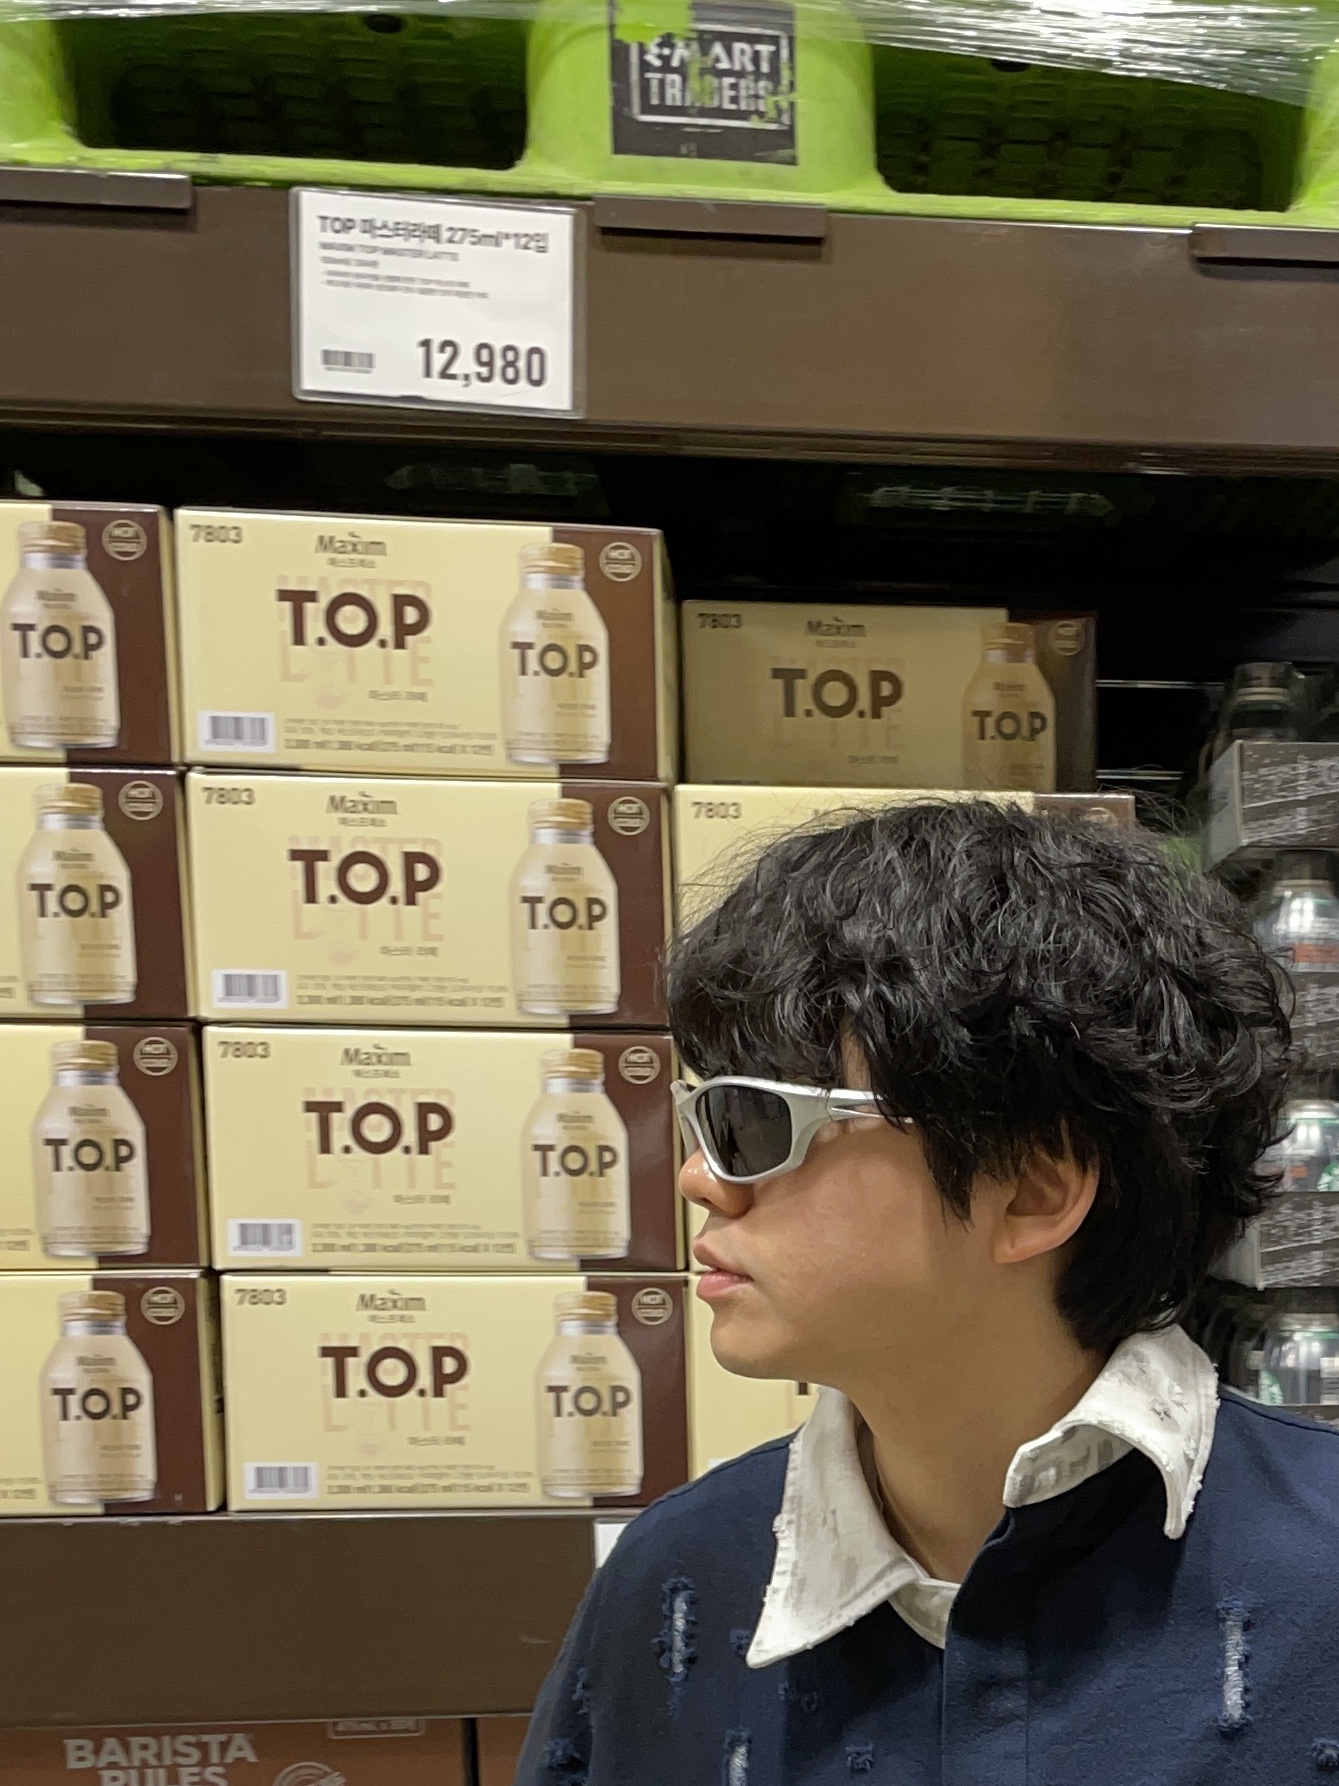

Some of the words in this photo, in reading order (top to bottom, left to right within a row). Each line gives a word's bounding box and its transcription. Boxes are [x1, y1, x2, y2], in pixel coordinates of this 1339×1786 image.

[317, 215, 355, 234] TOP
[417, 338, 548, 388] 12,980
[276, 588, 430, 650] T.O.P
[11, 624, 104, 660] T.O.P
[510, 641, 598, 678] T.O.P
[771, 667, 904, 719] T.O.P
[971, 710, 1048, 742] T.O.P
[287, 849, 441, 906] T.O.P
[29, 883, 121, 918] T.O.P
[520, 896, 606, 930] T.O.P
[303, 1100, 454, 1155] T.O.P
[43, 1138, 135, 1172] T.O.P
[532, 1143, 618, 1177] T.O.P
[318, 1345, 469, 1398] T.O.P
[51, 1387, 142, 1421] T.O.P
[546, 1385, 632, 1417] T.O.P
[63, 1732, 258, 1769] BARISTA
